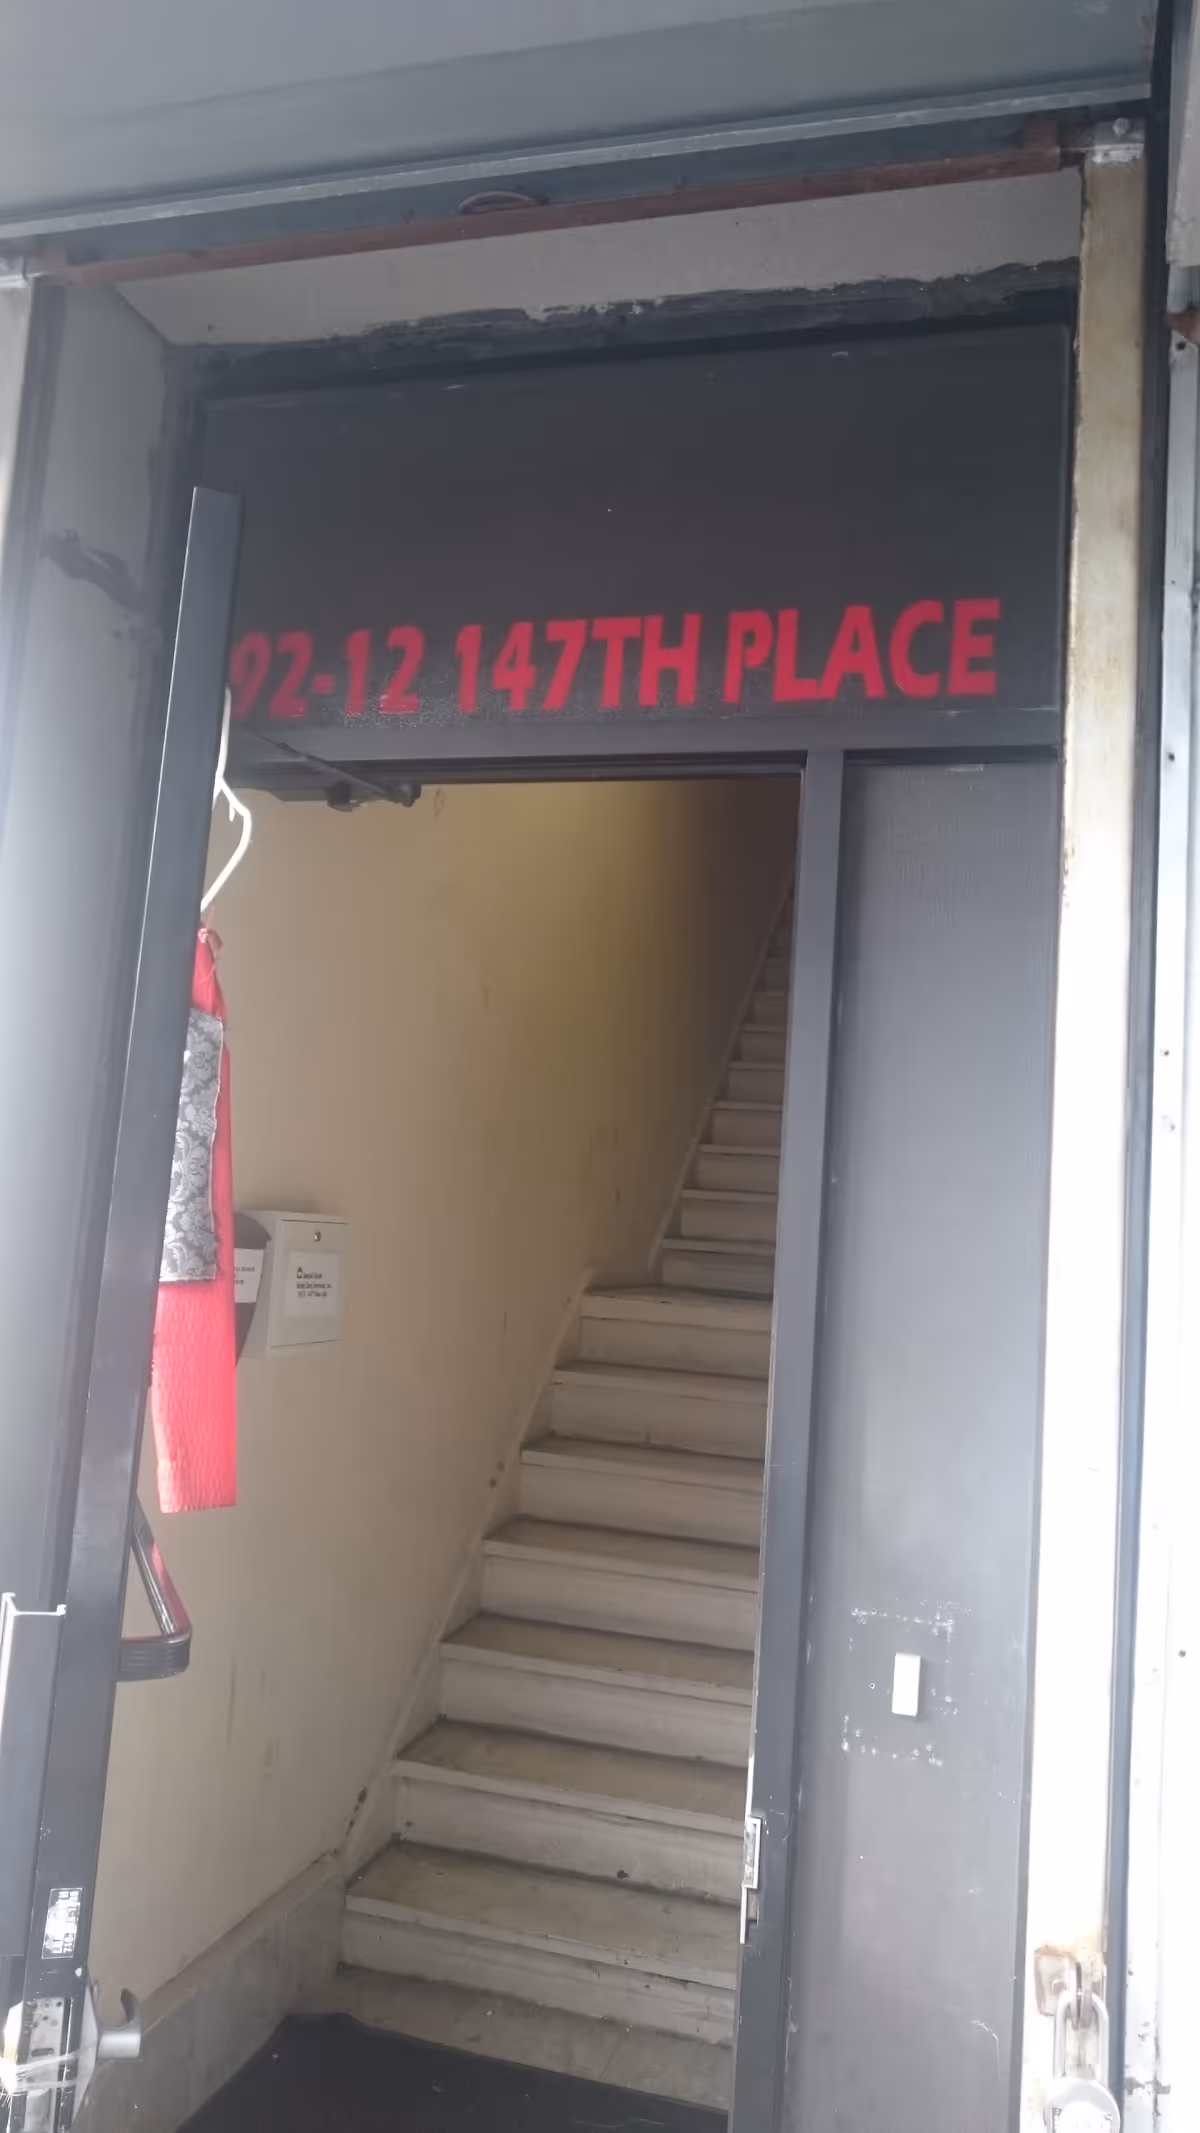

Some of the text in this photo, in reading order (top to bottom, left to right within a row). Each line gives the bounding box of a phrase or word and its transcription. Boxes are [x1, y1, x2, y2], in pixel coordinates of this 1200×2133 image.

[230, 598, 1001, 718] 92-12 147TH PLACE
